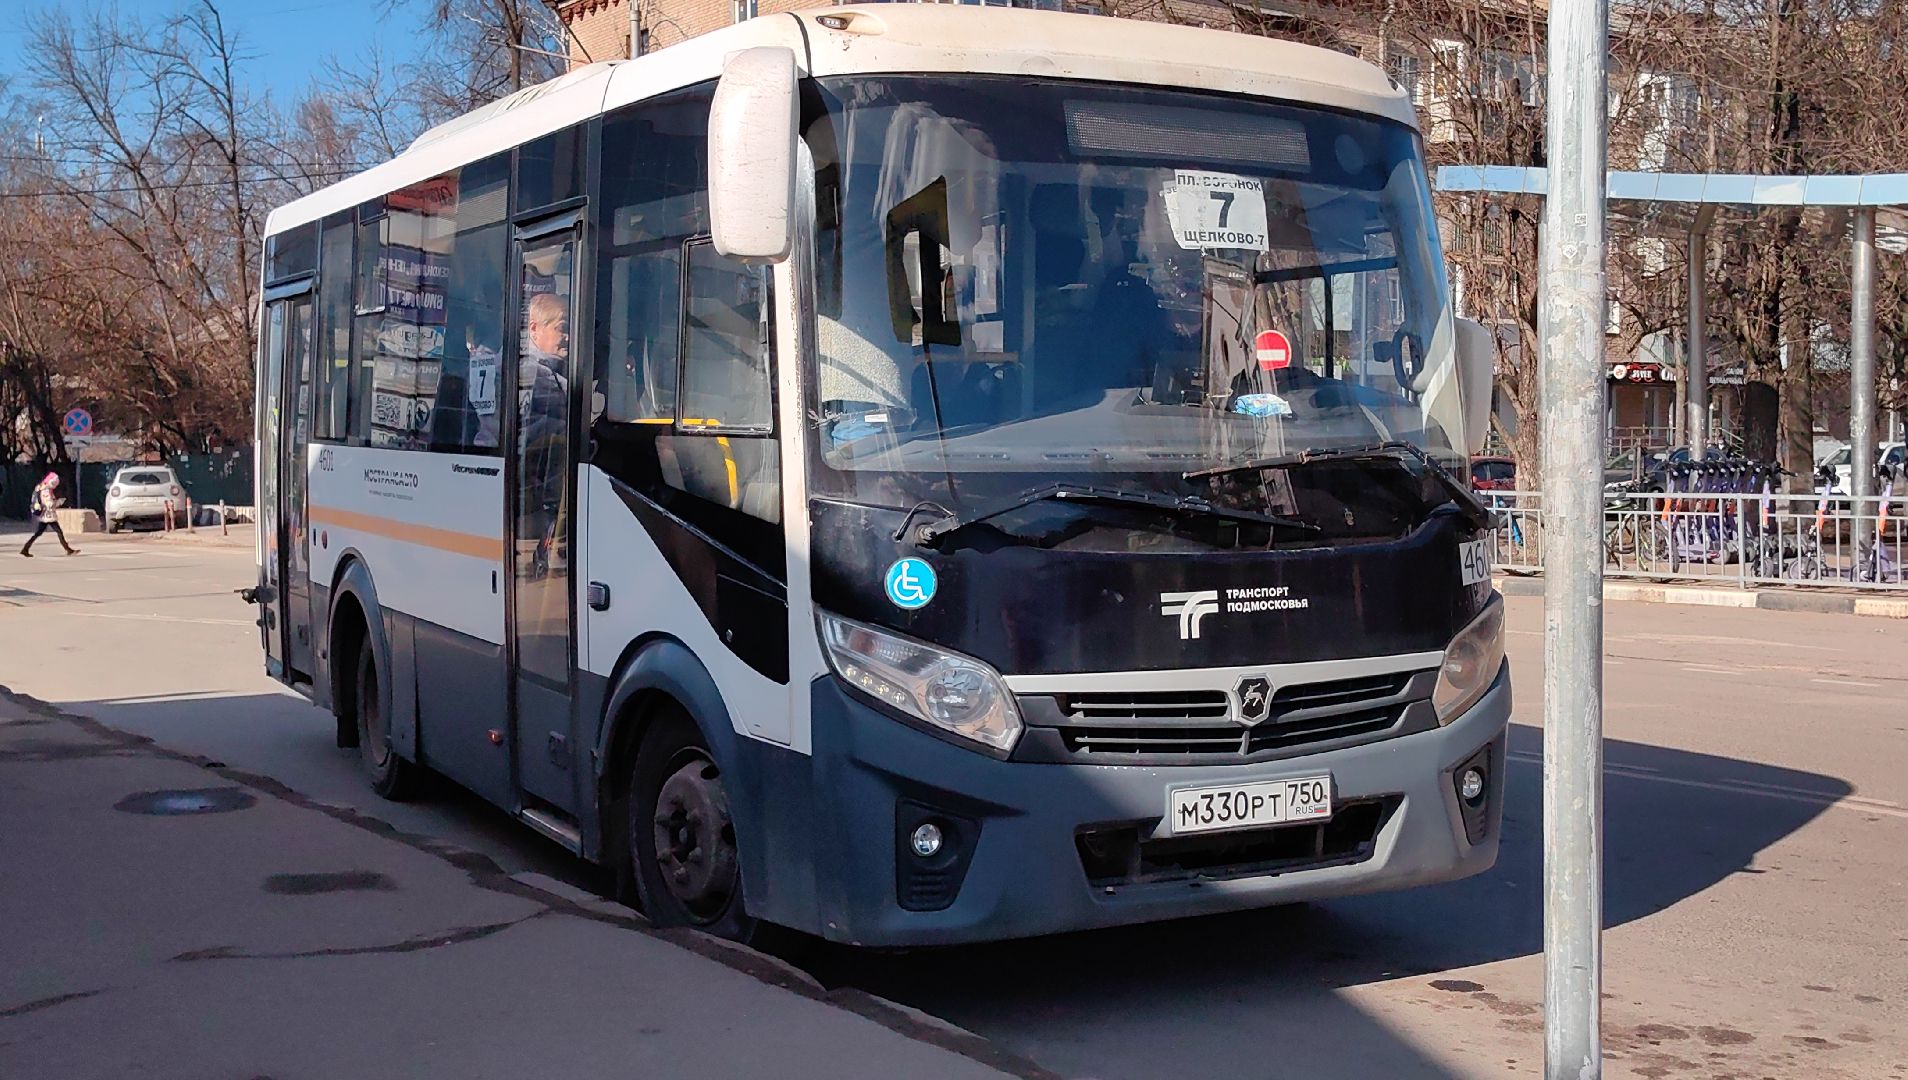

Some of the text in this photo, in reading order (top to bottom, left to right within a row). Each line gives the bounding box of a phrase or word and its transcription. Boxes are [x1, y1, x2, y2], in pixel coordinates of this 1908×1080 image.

[1177, 174, 1199, 186] ПЛ.
[1210, 190, 1235, 228] 7
[1183, 230, 1265, 246] ЩЕЛКОВО-7
[479, 369, 487, 398] 7
[318, 449, 334, 472] 4601
[1226, 586, 1289, 600] ТРАНСПОРТ
[1227, 599, 1309, 613] ПОДМОСКОВЬЯ
[1287, 781, 1323, 807] 750
[1295, 805, 1314, 815] RUS
